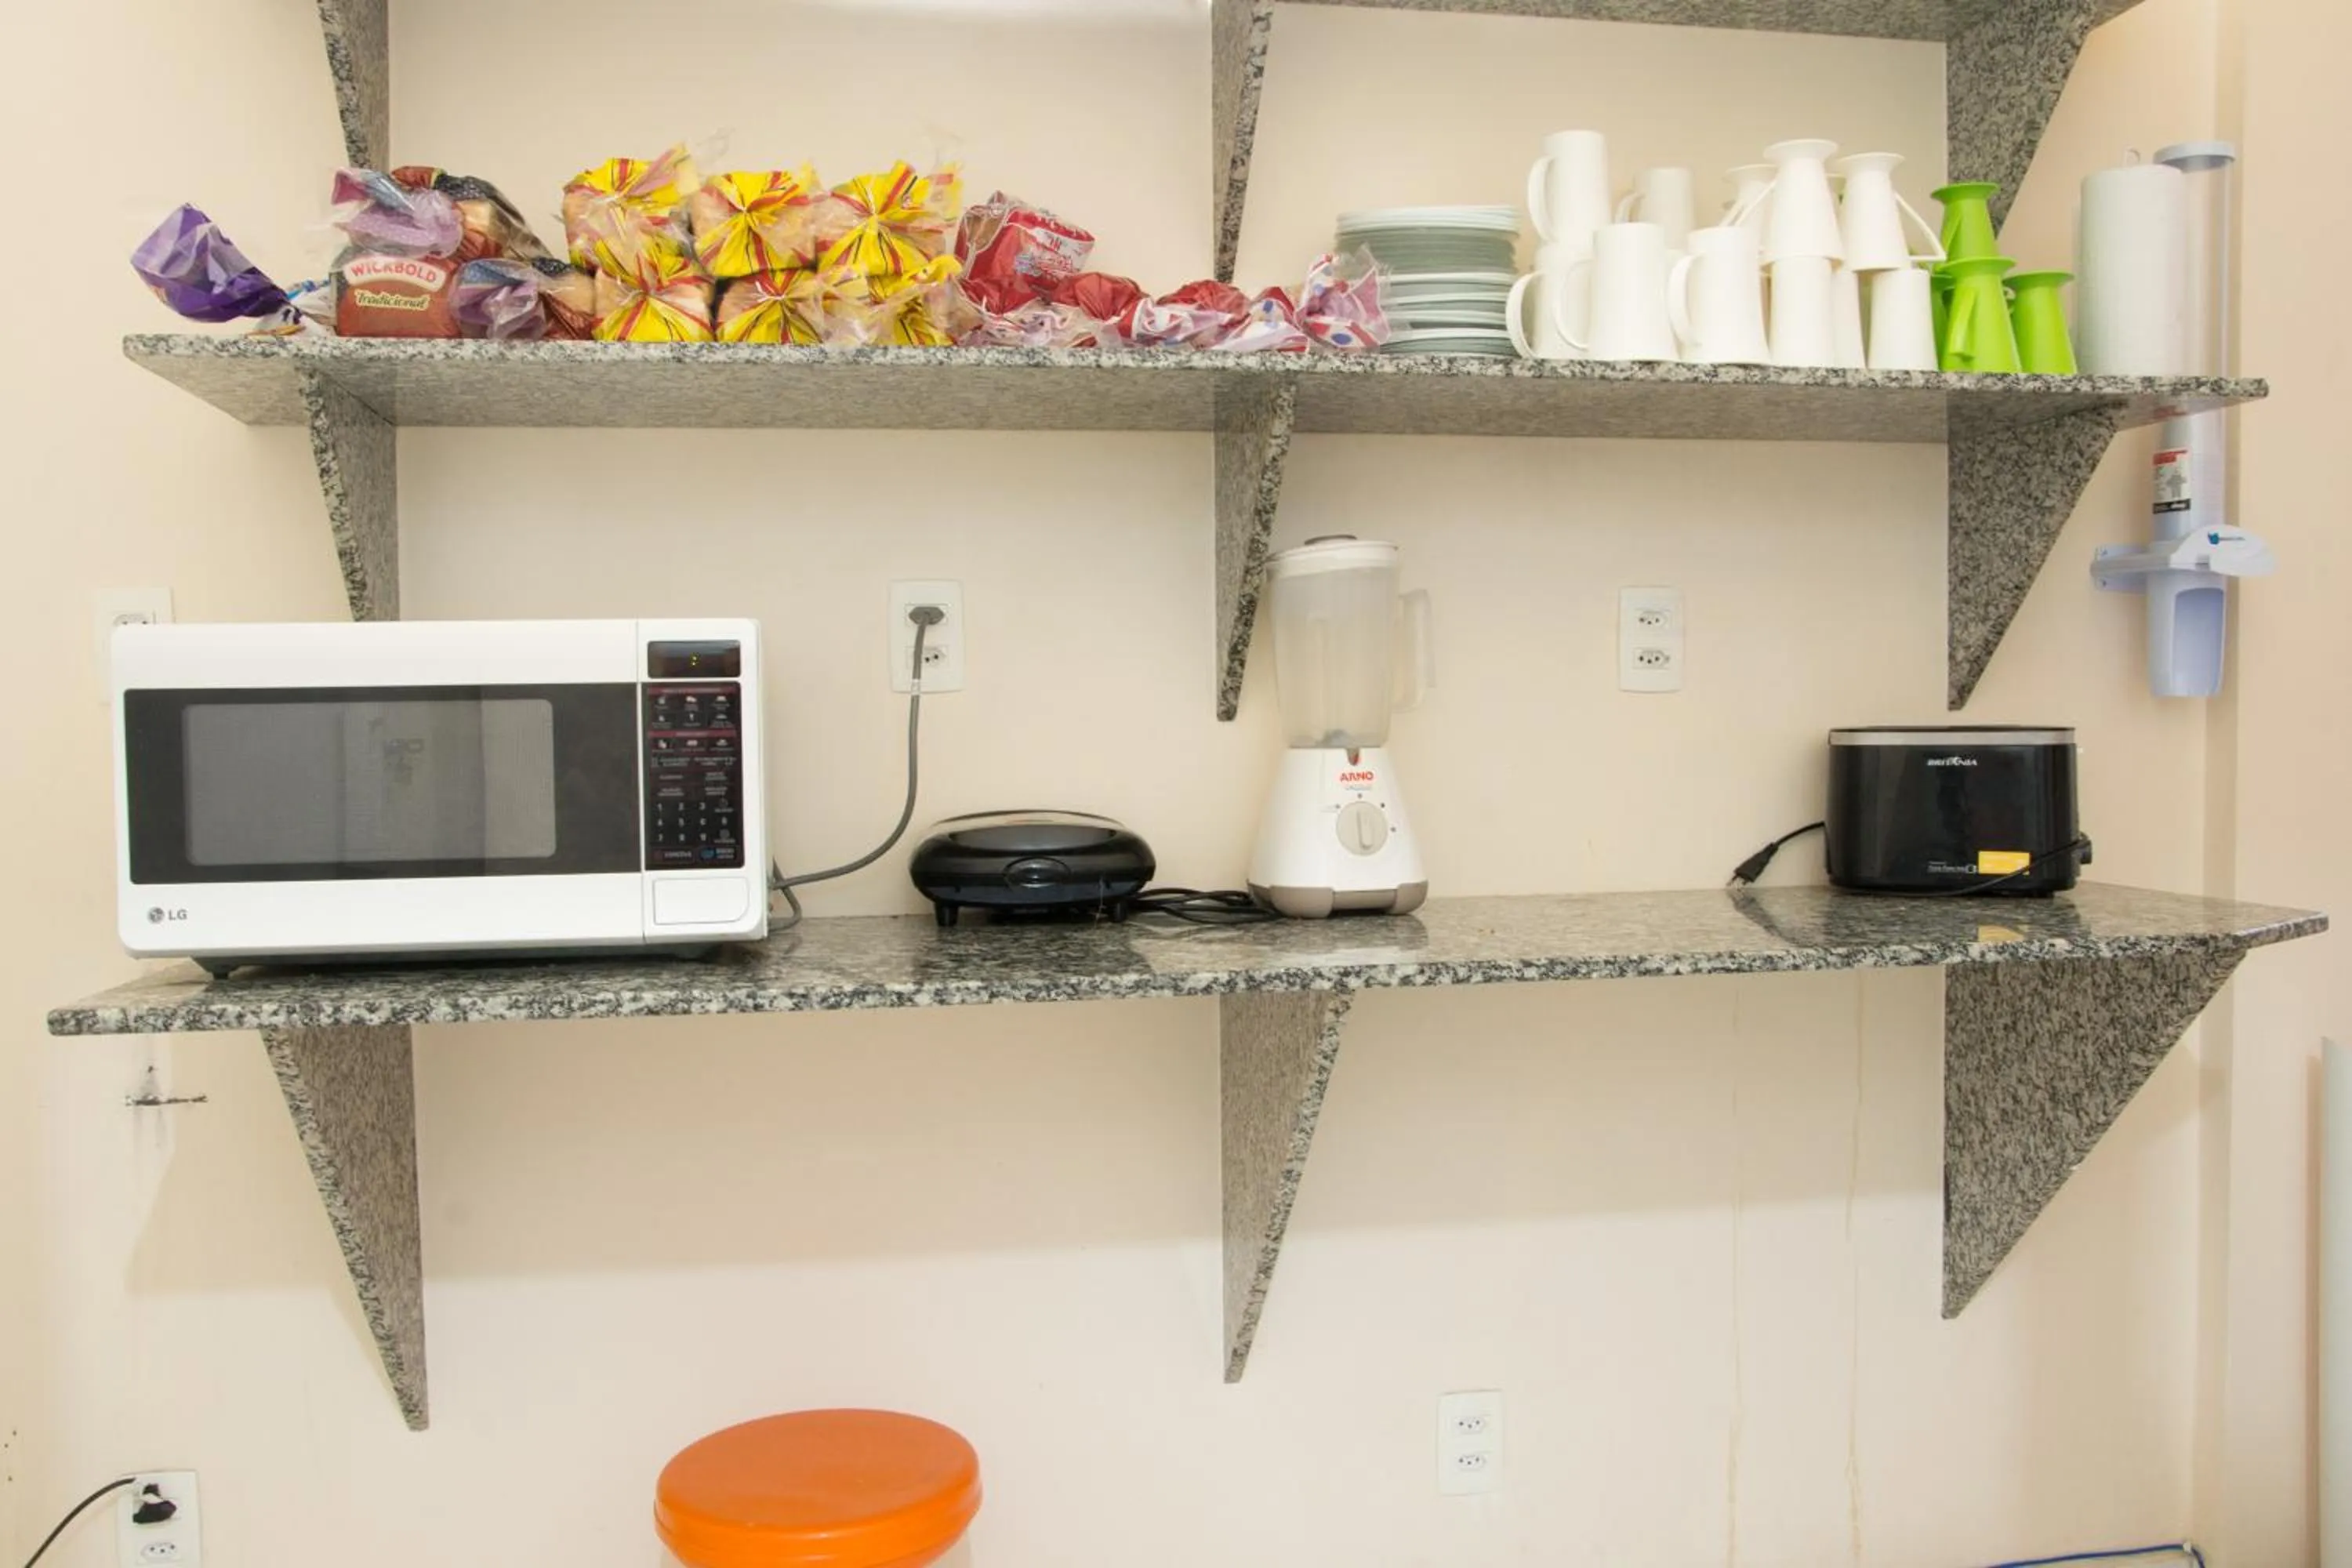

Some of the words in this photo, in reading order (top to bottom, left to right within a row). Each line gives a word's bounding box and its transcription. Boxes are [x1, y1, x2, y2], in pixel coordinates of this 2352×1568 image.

[350, 263, 437, 282] WICKBOLD
[1339, 771, 1374, 782] ARNO
[168, 909, 188, 921] LG
